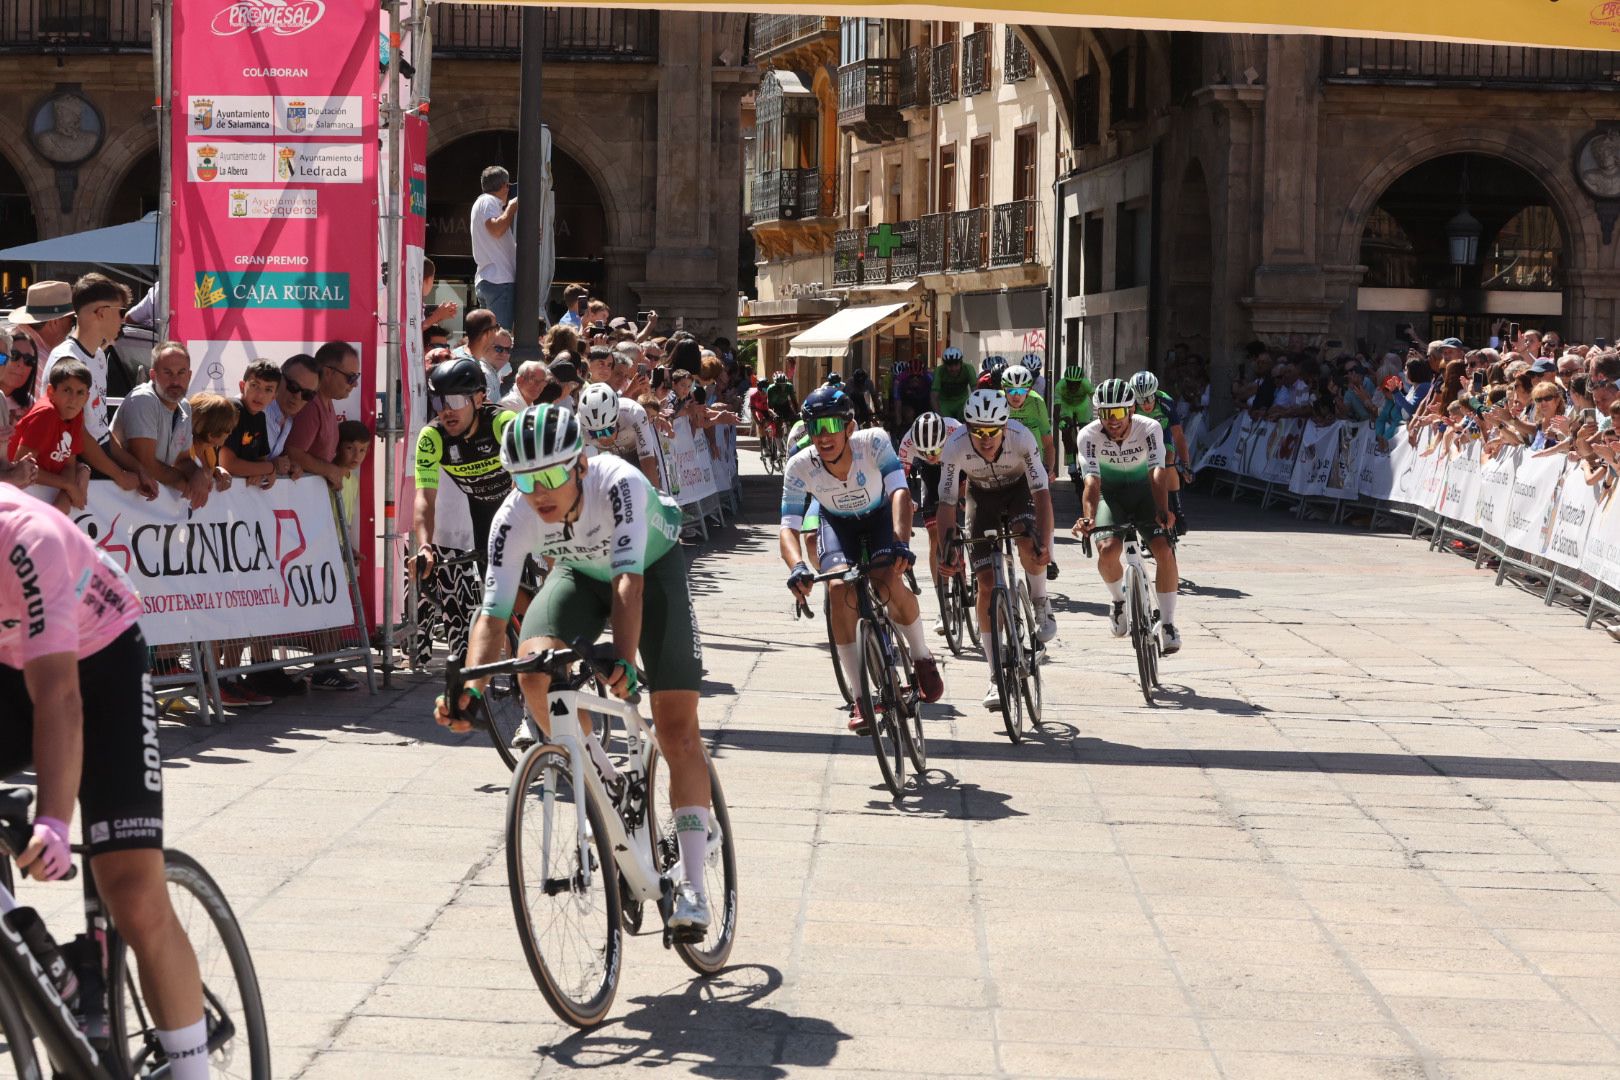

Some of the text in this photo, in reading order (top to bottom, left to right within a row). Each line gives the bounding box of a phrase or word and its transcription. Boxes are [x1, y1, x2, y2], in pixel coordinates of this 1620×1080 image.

[229, 6, 313, 25] PROMESAL
[242, 67, 308, 78] COLABORAN
[216, 109, 270, 119] Ayuntamiento
[307, 107, 347, 117] Diputación
[216, 119, 270, 129] de Salamanca
[315, 120, 355, 129] Salamanca
[219, 151, 267, 161] Ayuntamiento de
[299, 154, 363, 163] Ayuntamiento de
[219, 166, 248, 176] La Alberca
[300, 165, 348, 177] Ledrada
[252, 197, 317, 207] Ayuntamiento
[263, 205, 317, 216] Sequeros
[234, 255, 309, 265] GRAN PREMIO
[233, 284, 344, 304] CAJA RURAL
[1109, 456, 1138, 464] ALEA
[608, 484, 624, 528] RGA
[618, 478, 634, 524] SEGUROS
[131, 507, 275, 578] CLÍNICA
[493, 524, 513, 567] RGA
[9, 544, 46, 640] GOMUR
[215, 591, 223, 608] Y
[224, 584, 280, 608] OSTEOPATÍA
[115, 828, 157, 839] DEPORTE
